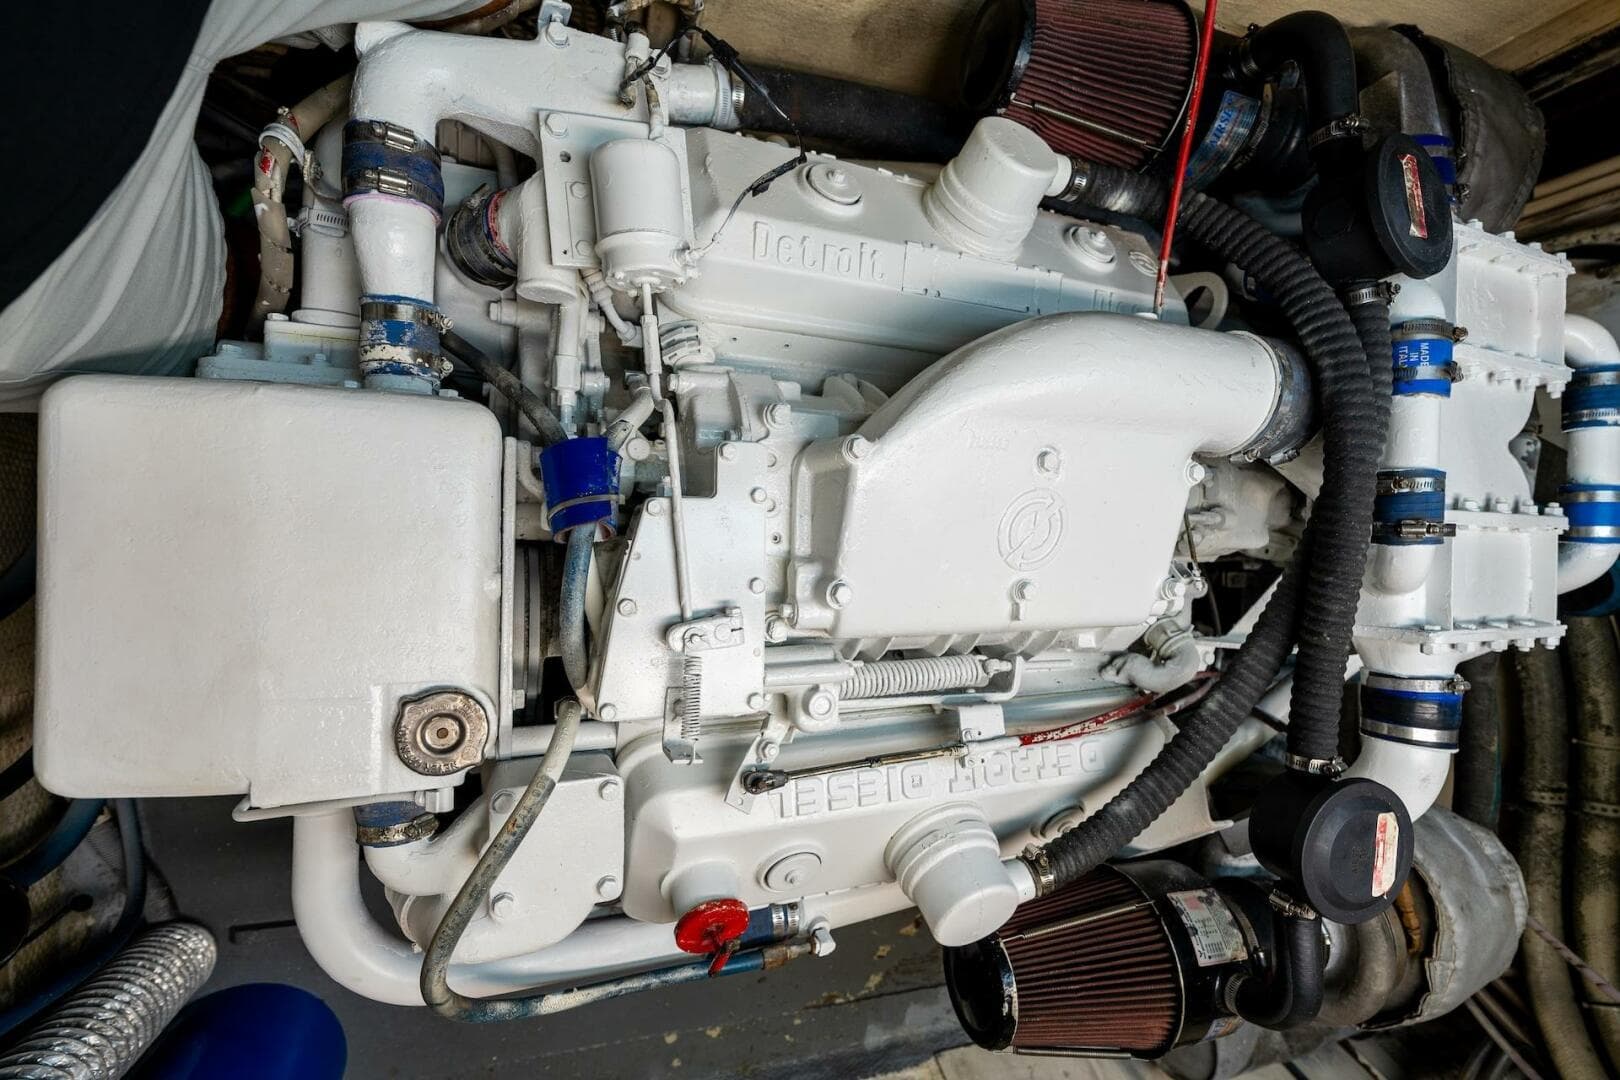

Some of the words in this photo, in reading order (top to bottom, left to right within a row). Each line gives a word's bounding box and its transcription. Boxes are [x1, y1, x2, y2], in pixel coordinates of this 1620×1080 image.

[752, 220, 886, 281] Detroit
[1409, 352, 1419, 362] IN
[1420, 342, 1430, 367] MADE
[767, 762, 929, 819] DIESEL
[949, 740, 1104, 793] DETROIT
